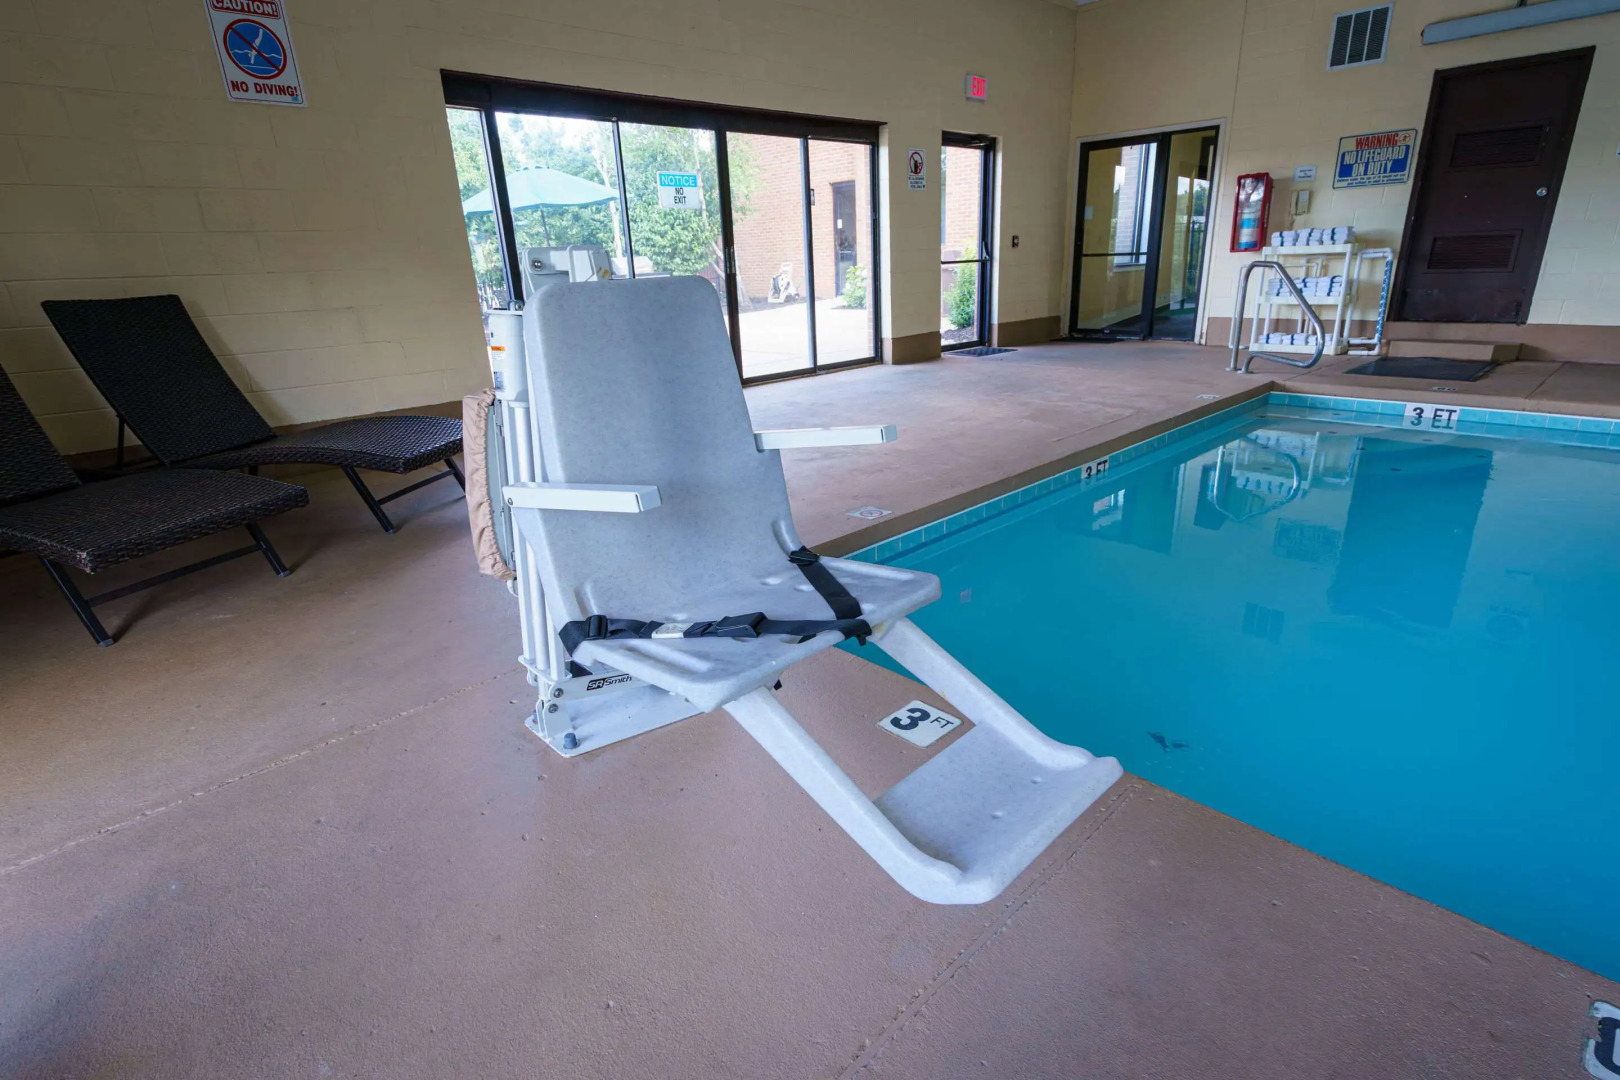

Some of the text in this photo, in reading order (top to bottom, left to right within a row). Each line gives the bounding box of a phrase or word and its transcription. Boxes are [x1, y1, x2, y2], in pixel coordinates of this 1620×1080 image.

[212, 0, 279, 15] CAUTION!
[230, 81, 298, 97] NO DIVING!
[971, 76, 986, 98] EXIT
[1355, 133, 1399, 150] WARNING
[1343, 145, 1406, 165] NO LIFEGUARD
[1352, 160, 1393, 177] ON DUTY
[661, 175, 696, 186] NOTICE
[673, 196, 687, 204] EXIT
[674, 187, 684, 196] NO
[1410, 407, 1425, 426] 3
[890, 707, 954, 731] 3 FT
